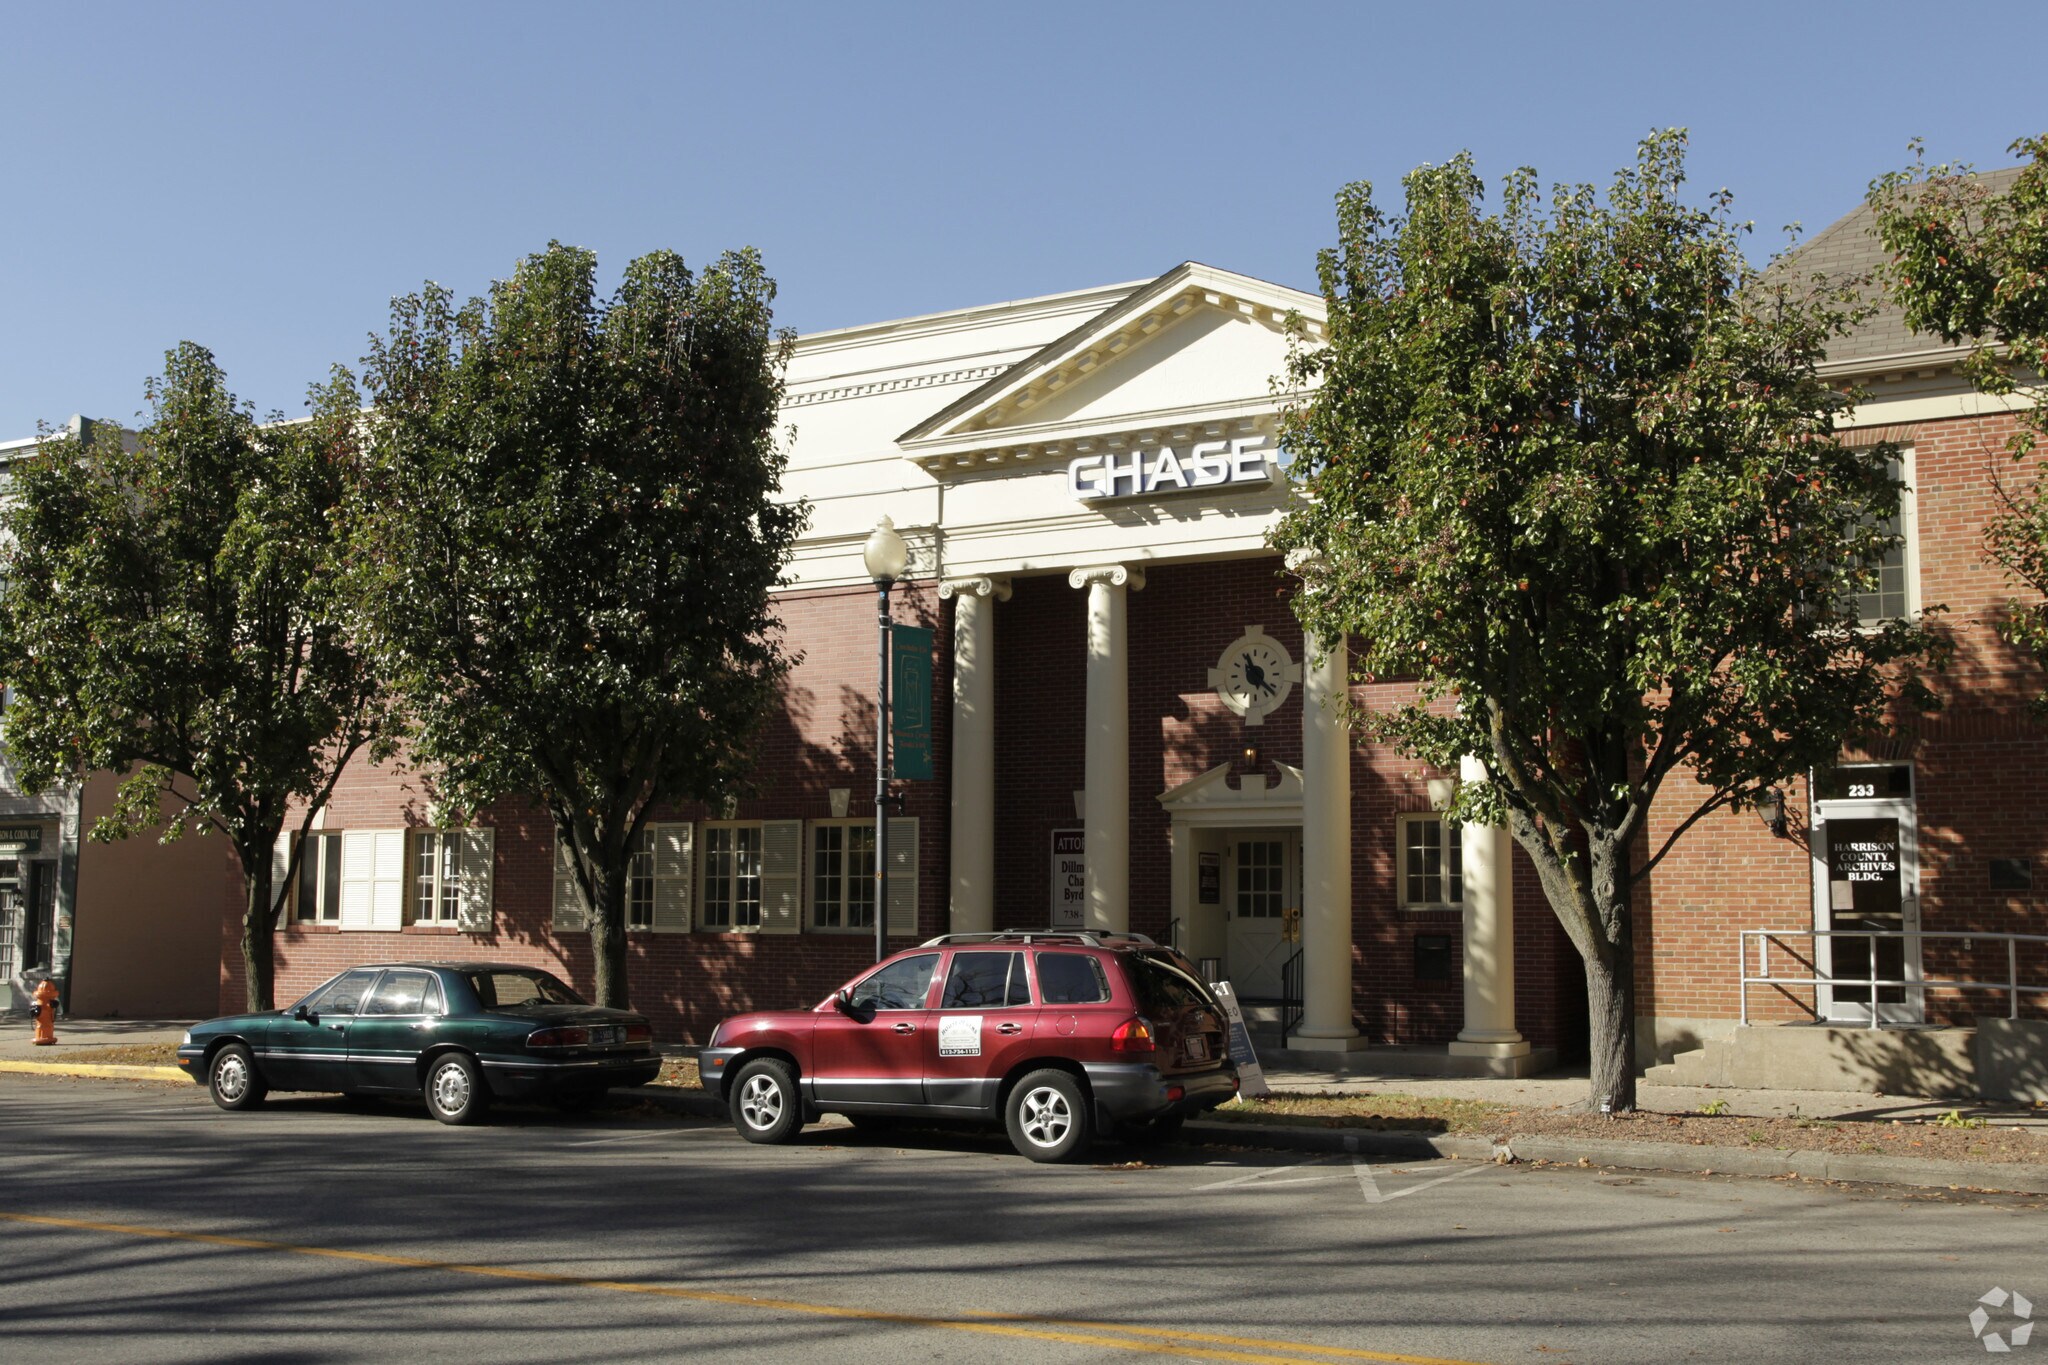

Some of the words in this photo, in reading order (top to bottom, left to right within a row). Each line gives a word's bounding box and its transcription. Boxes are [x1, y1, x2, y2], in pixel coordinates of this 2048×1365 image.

[1068, 436, 1268, 500] CHASE
[1848, 784, 1875, 797] 233
[1834, 842, 1895, 851] HARRISON
[1840, 852, 1889, 862] COUNTY
[1835, 862, 1895, 872] ARCHIVES
[1848, 872, 1883, 881] BLDG.
